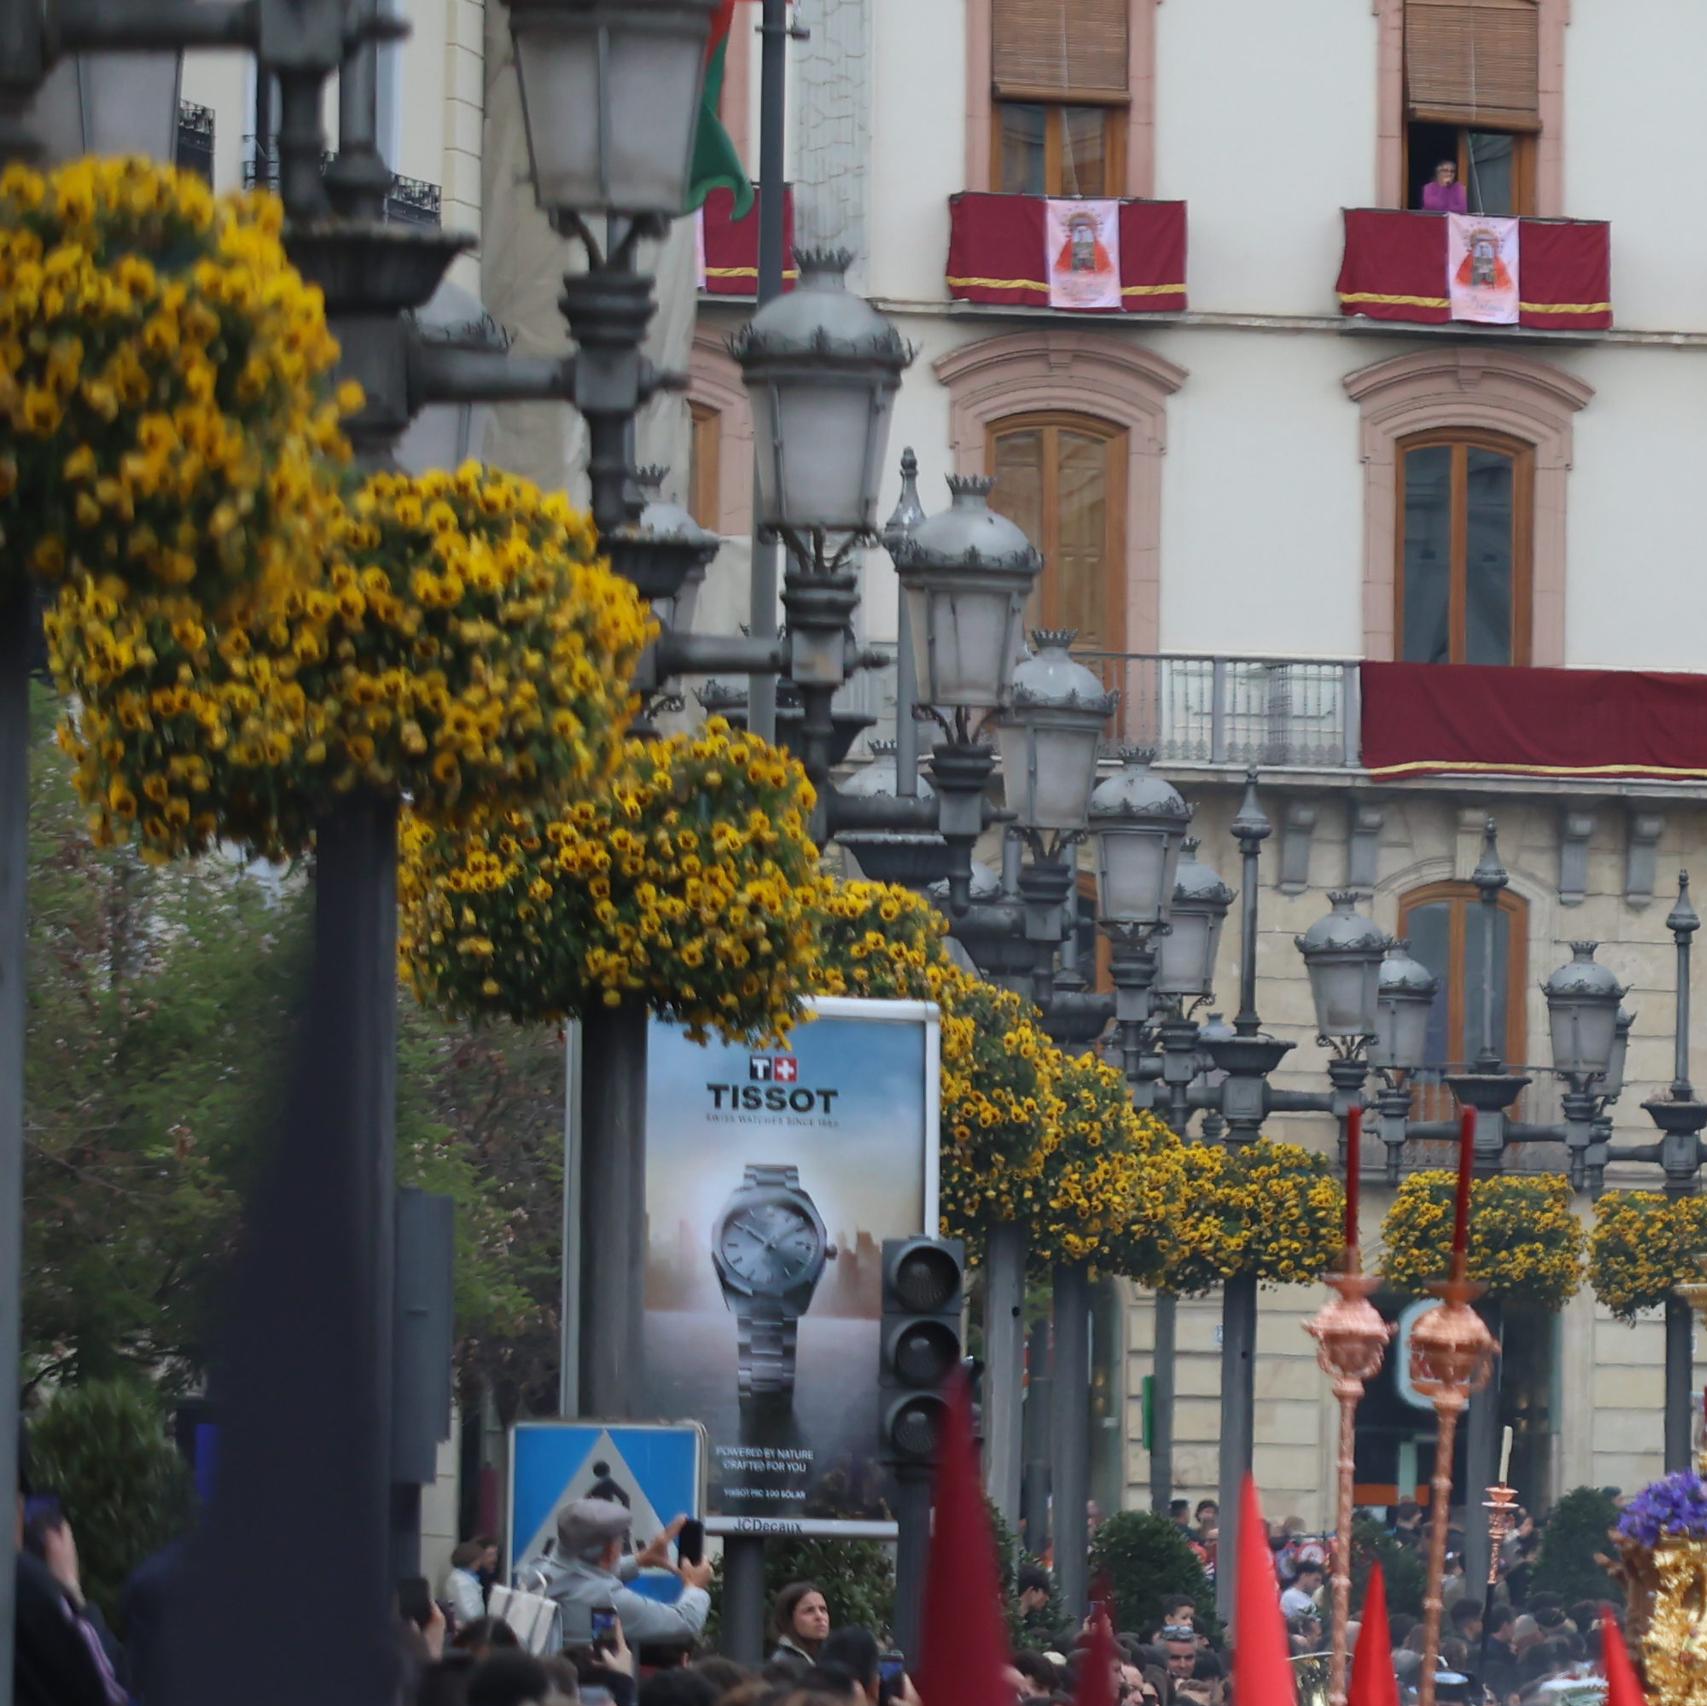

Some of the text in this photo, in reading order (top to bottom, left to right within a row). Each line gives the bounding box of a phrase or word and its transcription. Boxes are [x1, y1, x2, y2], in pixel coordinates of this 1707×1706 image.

[706, 1083, 839, 1114] TISSOT
[715, 1446, 814, 1460] POWERED BY NATURE
[722, 1459, 807, 1473] CRAFTED FOR YOU
[733, 1517, 804, 1534] JCDecaux
